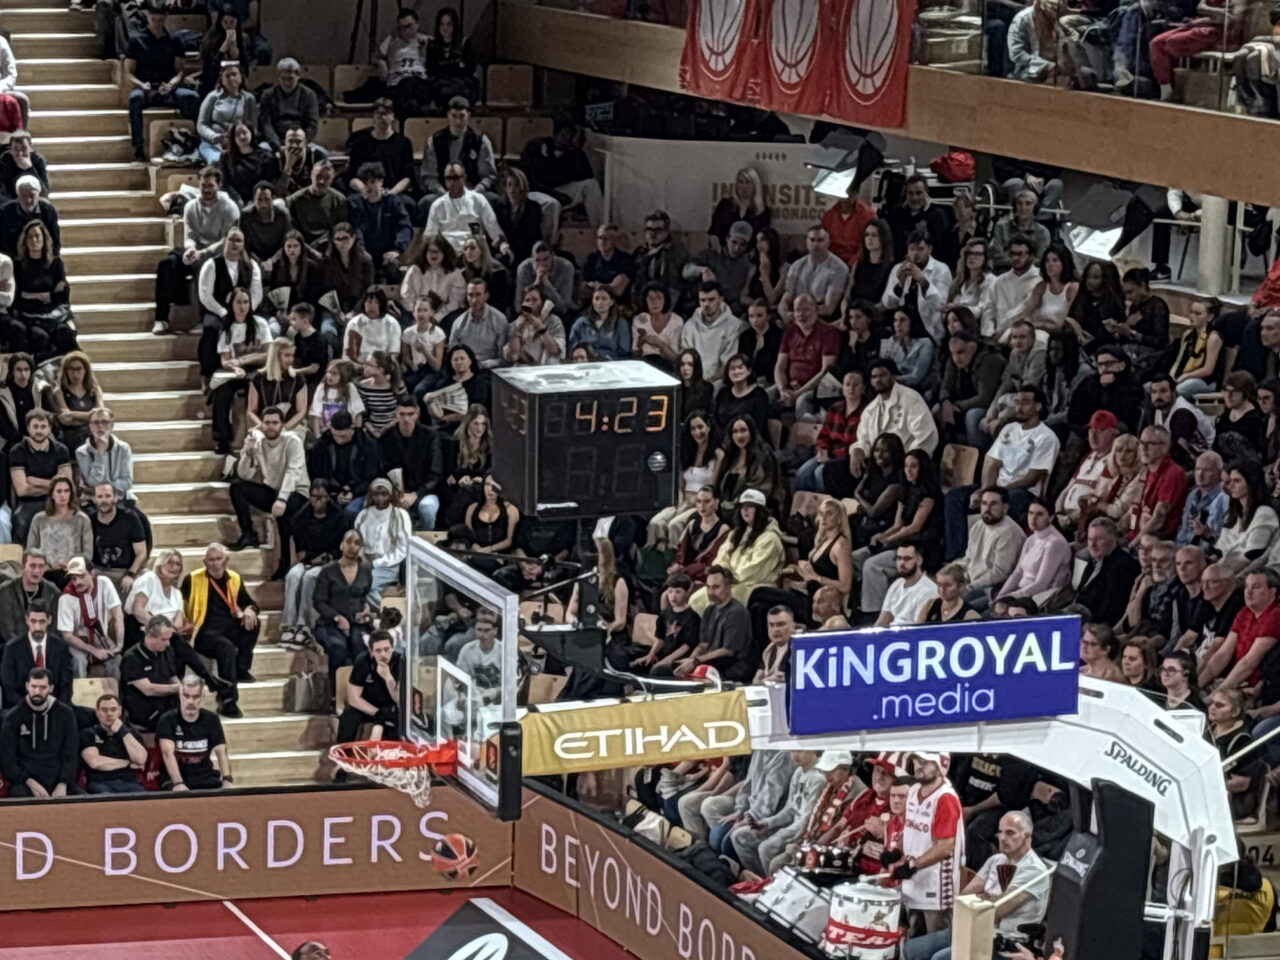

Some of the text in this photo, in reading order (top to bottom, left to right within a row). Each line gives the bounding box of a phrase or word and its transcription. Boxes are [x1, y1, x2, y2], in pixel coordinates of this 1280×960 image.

[575, 395, 669, 434] 4:23
[871, 683, 995, 721] .media
[553, 721, 747, 760] ETIHAD
[1104, 740, 1173, 798] SPALDING
[105, 810, 449, 876] BORDERS
[540, 823, 663, 936] BEYOND
